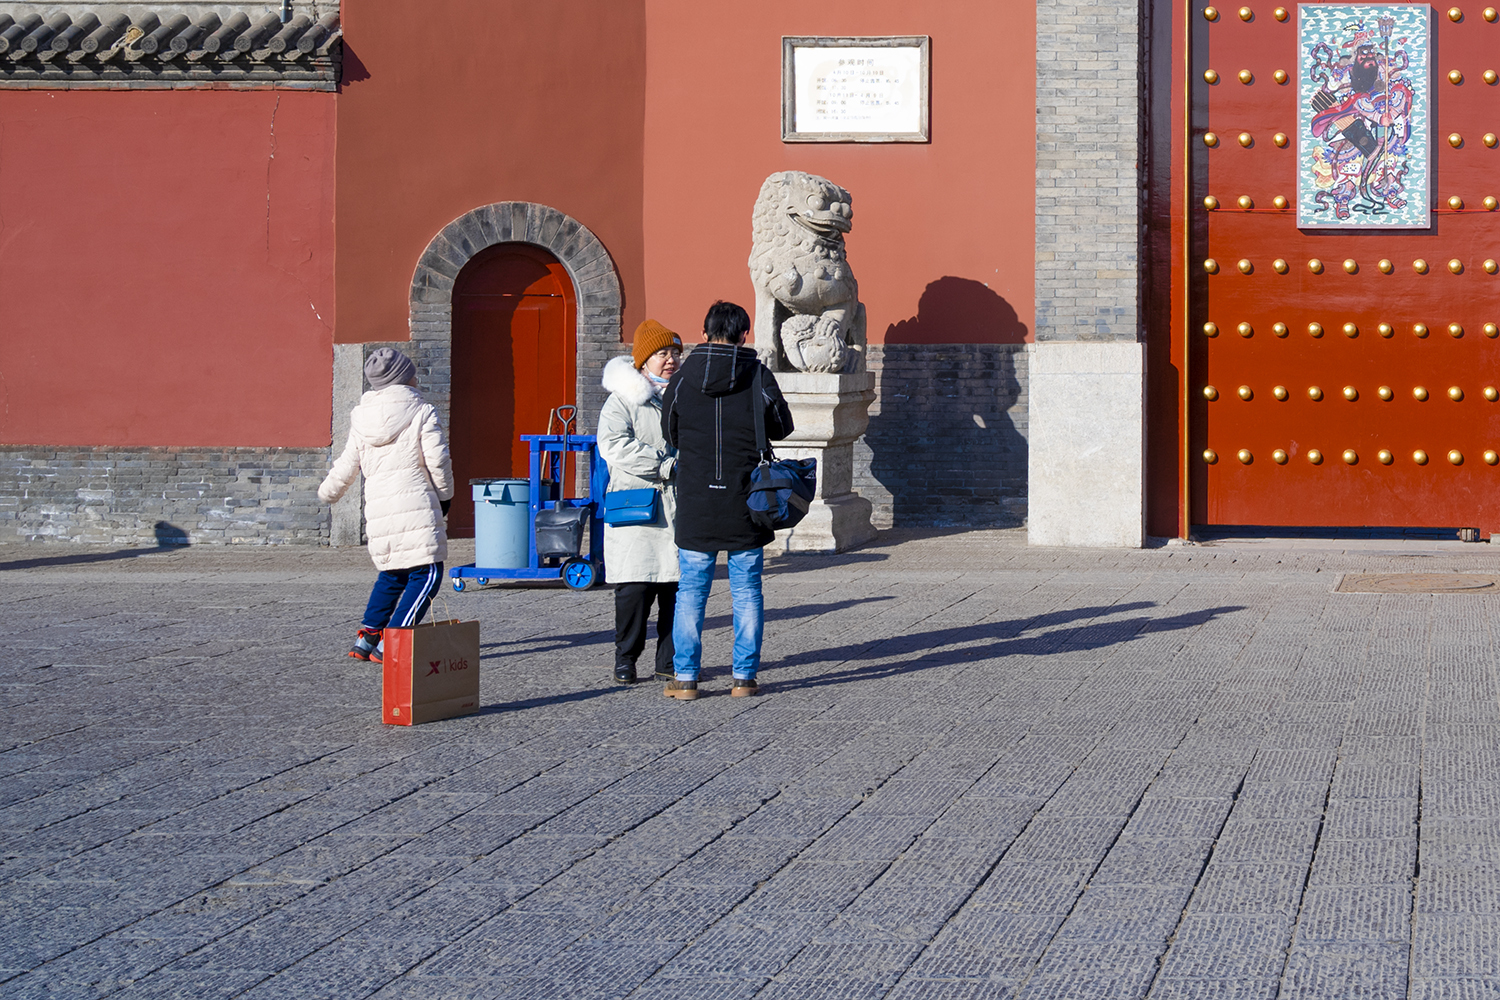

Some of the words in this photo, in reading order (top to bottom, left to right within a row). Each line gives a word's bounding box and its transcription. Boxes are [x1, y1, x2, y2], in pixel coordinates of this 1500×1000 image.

[838, 58, 874, 66] 参观时间
[449, 658, 468, 672] kids
